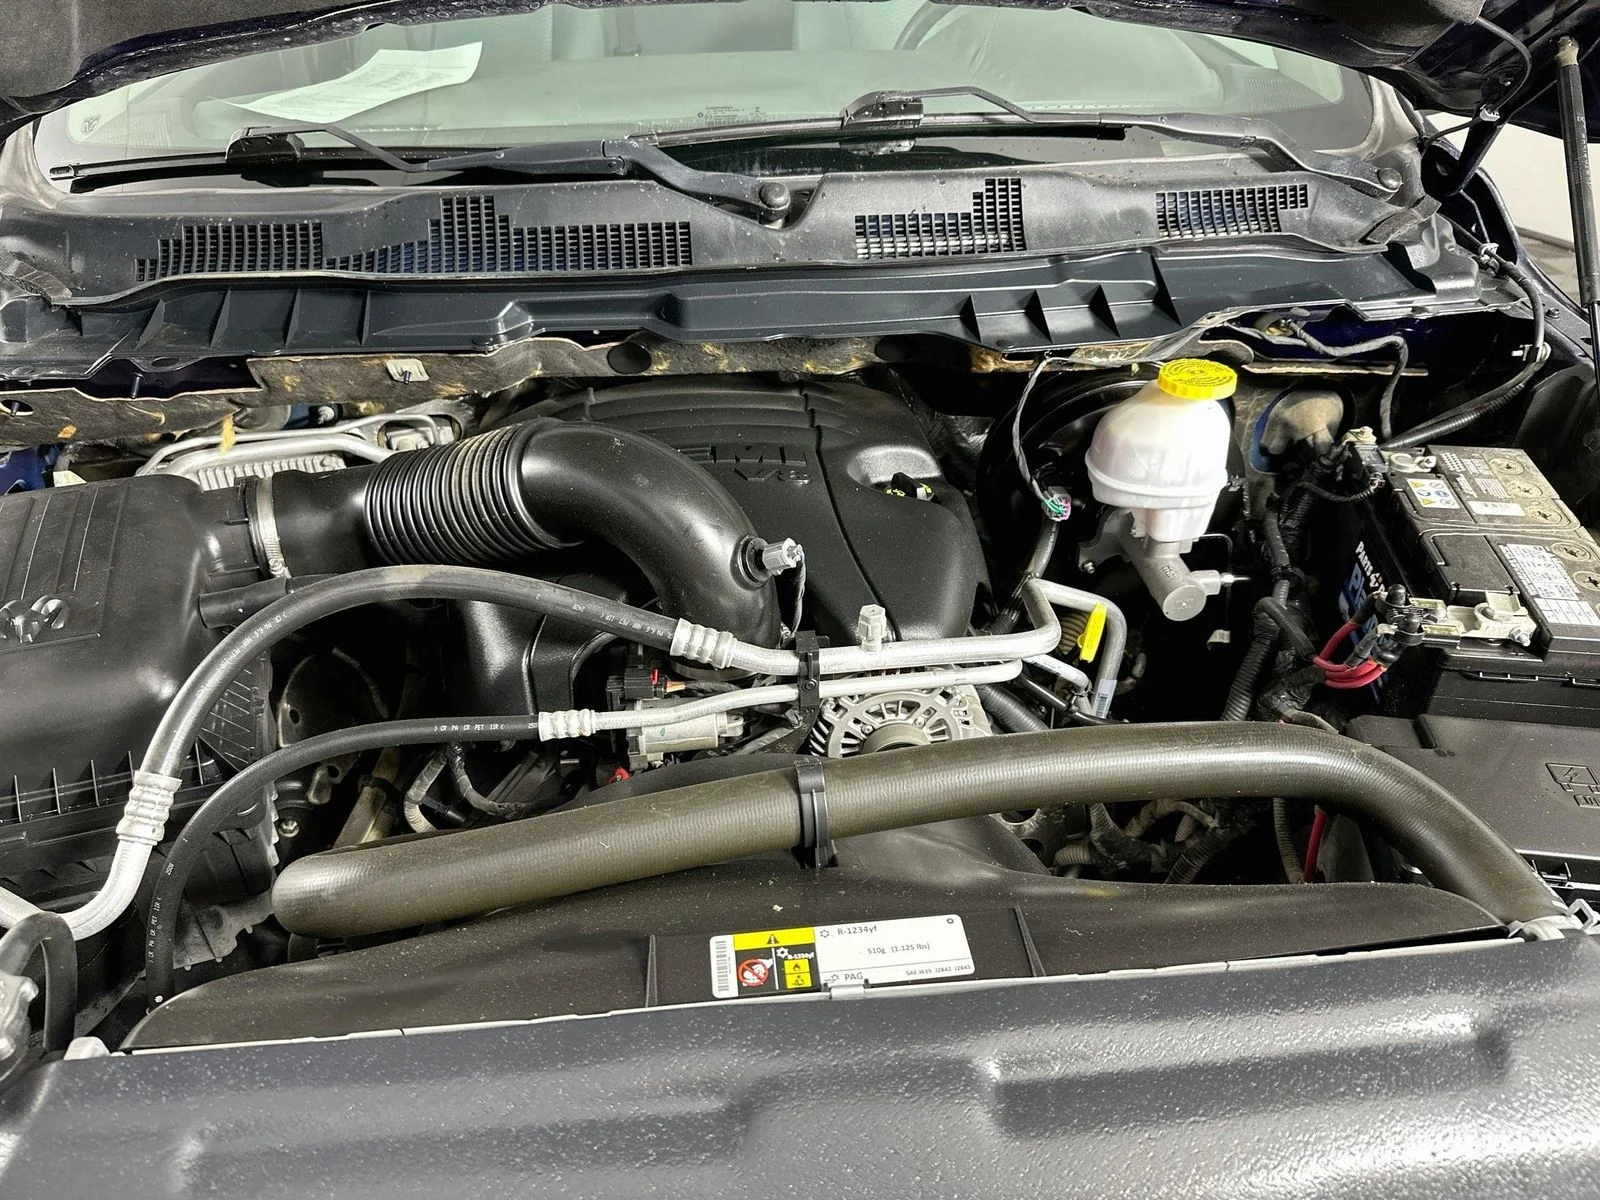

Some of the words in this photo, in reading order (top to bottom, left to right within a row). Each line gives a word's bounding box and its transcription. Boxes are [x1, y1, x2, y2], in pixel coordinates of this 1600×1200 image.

[732, 467, 813, 485] V8
[837, 925, 877, 936] R-1234yf
[891, 944, 915, 953] (1.125
[916, 942, 931, 950] lbs)
[844, 972, 864, 981] PAG
